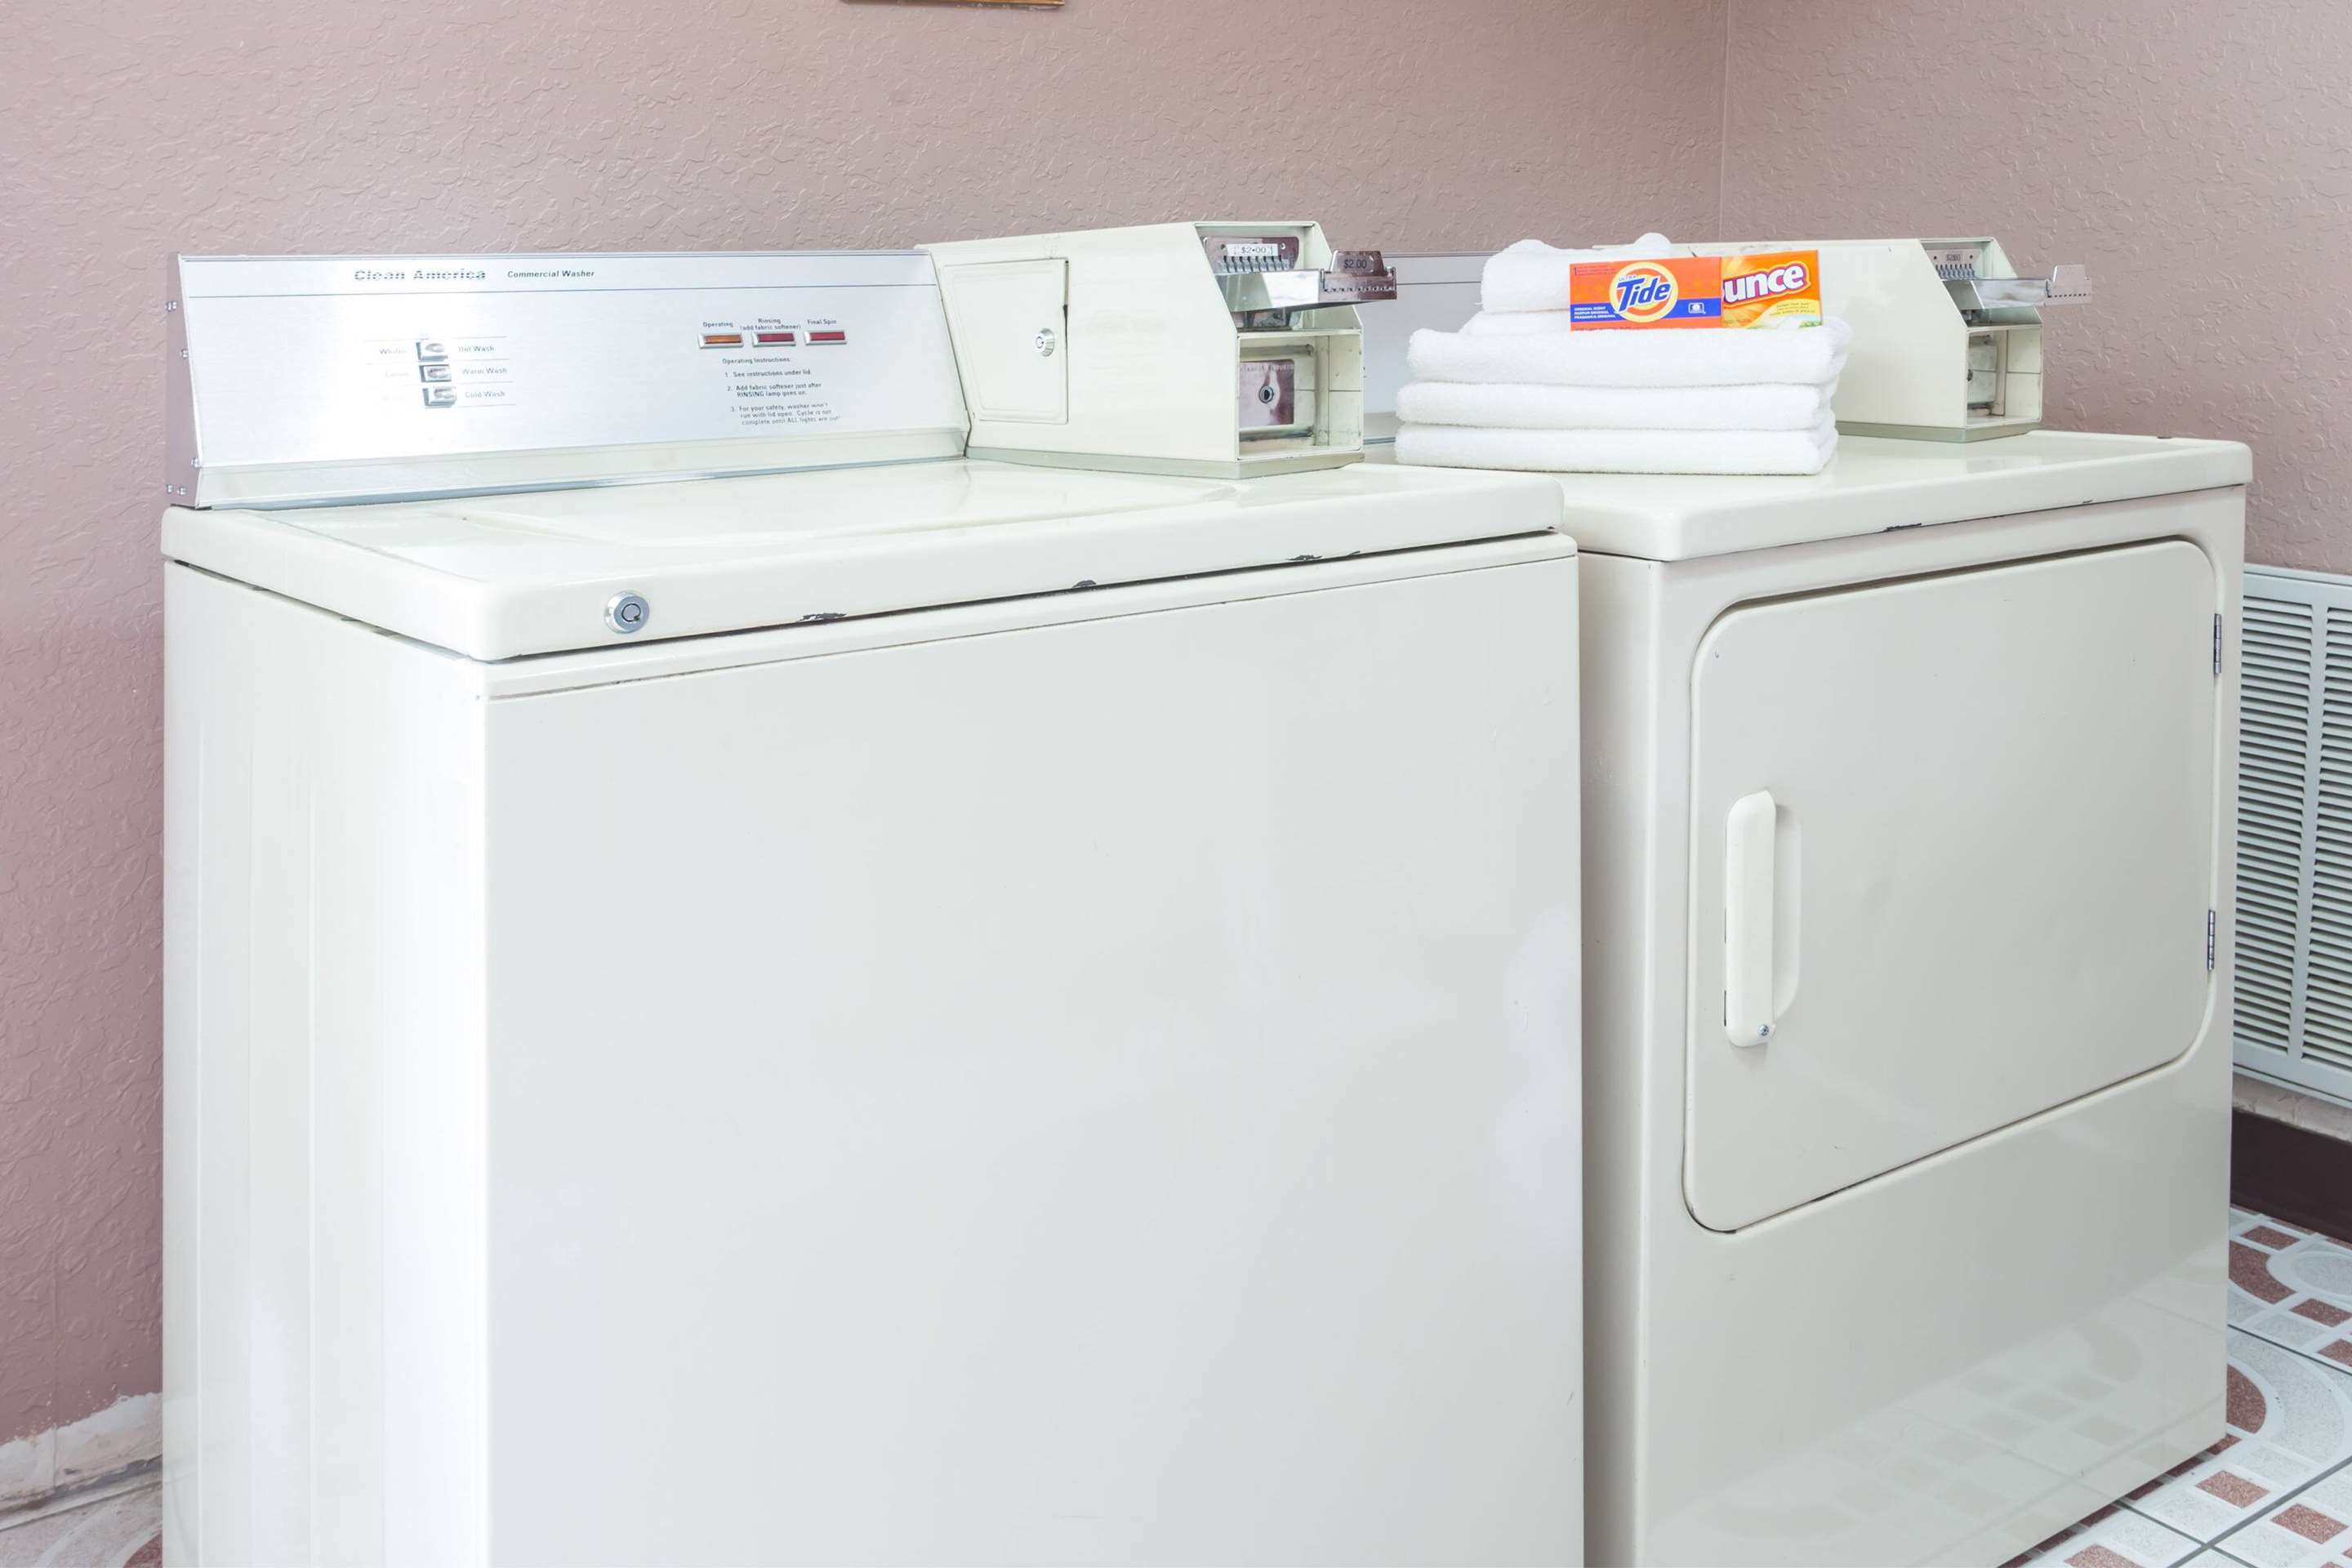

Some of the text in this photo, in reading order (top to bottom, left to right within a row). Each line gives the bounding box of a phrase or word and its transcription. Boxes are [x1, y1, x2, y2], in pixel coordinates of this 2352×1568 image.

[1343, 259, 1367, 269] $2.00
[353, 269, 486, 280] Clean America
[506, 270, 559, 279] Commercial
[1724, 265, 1804, 303] unce
[1616, 277, 1671, 312] Tide
